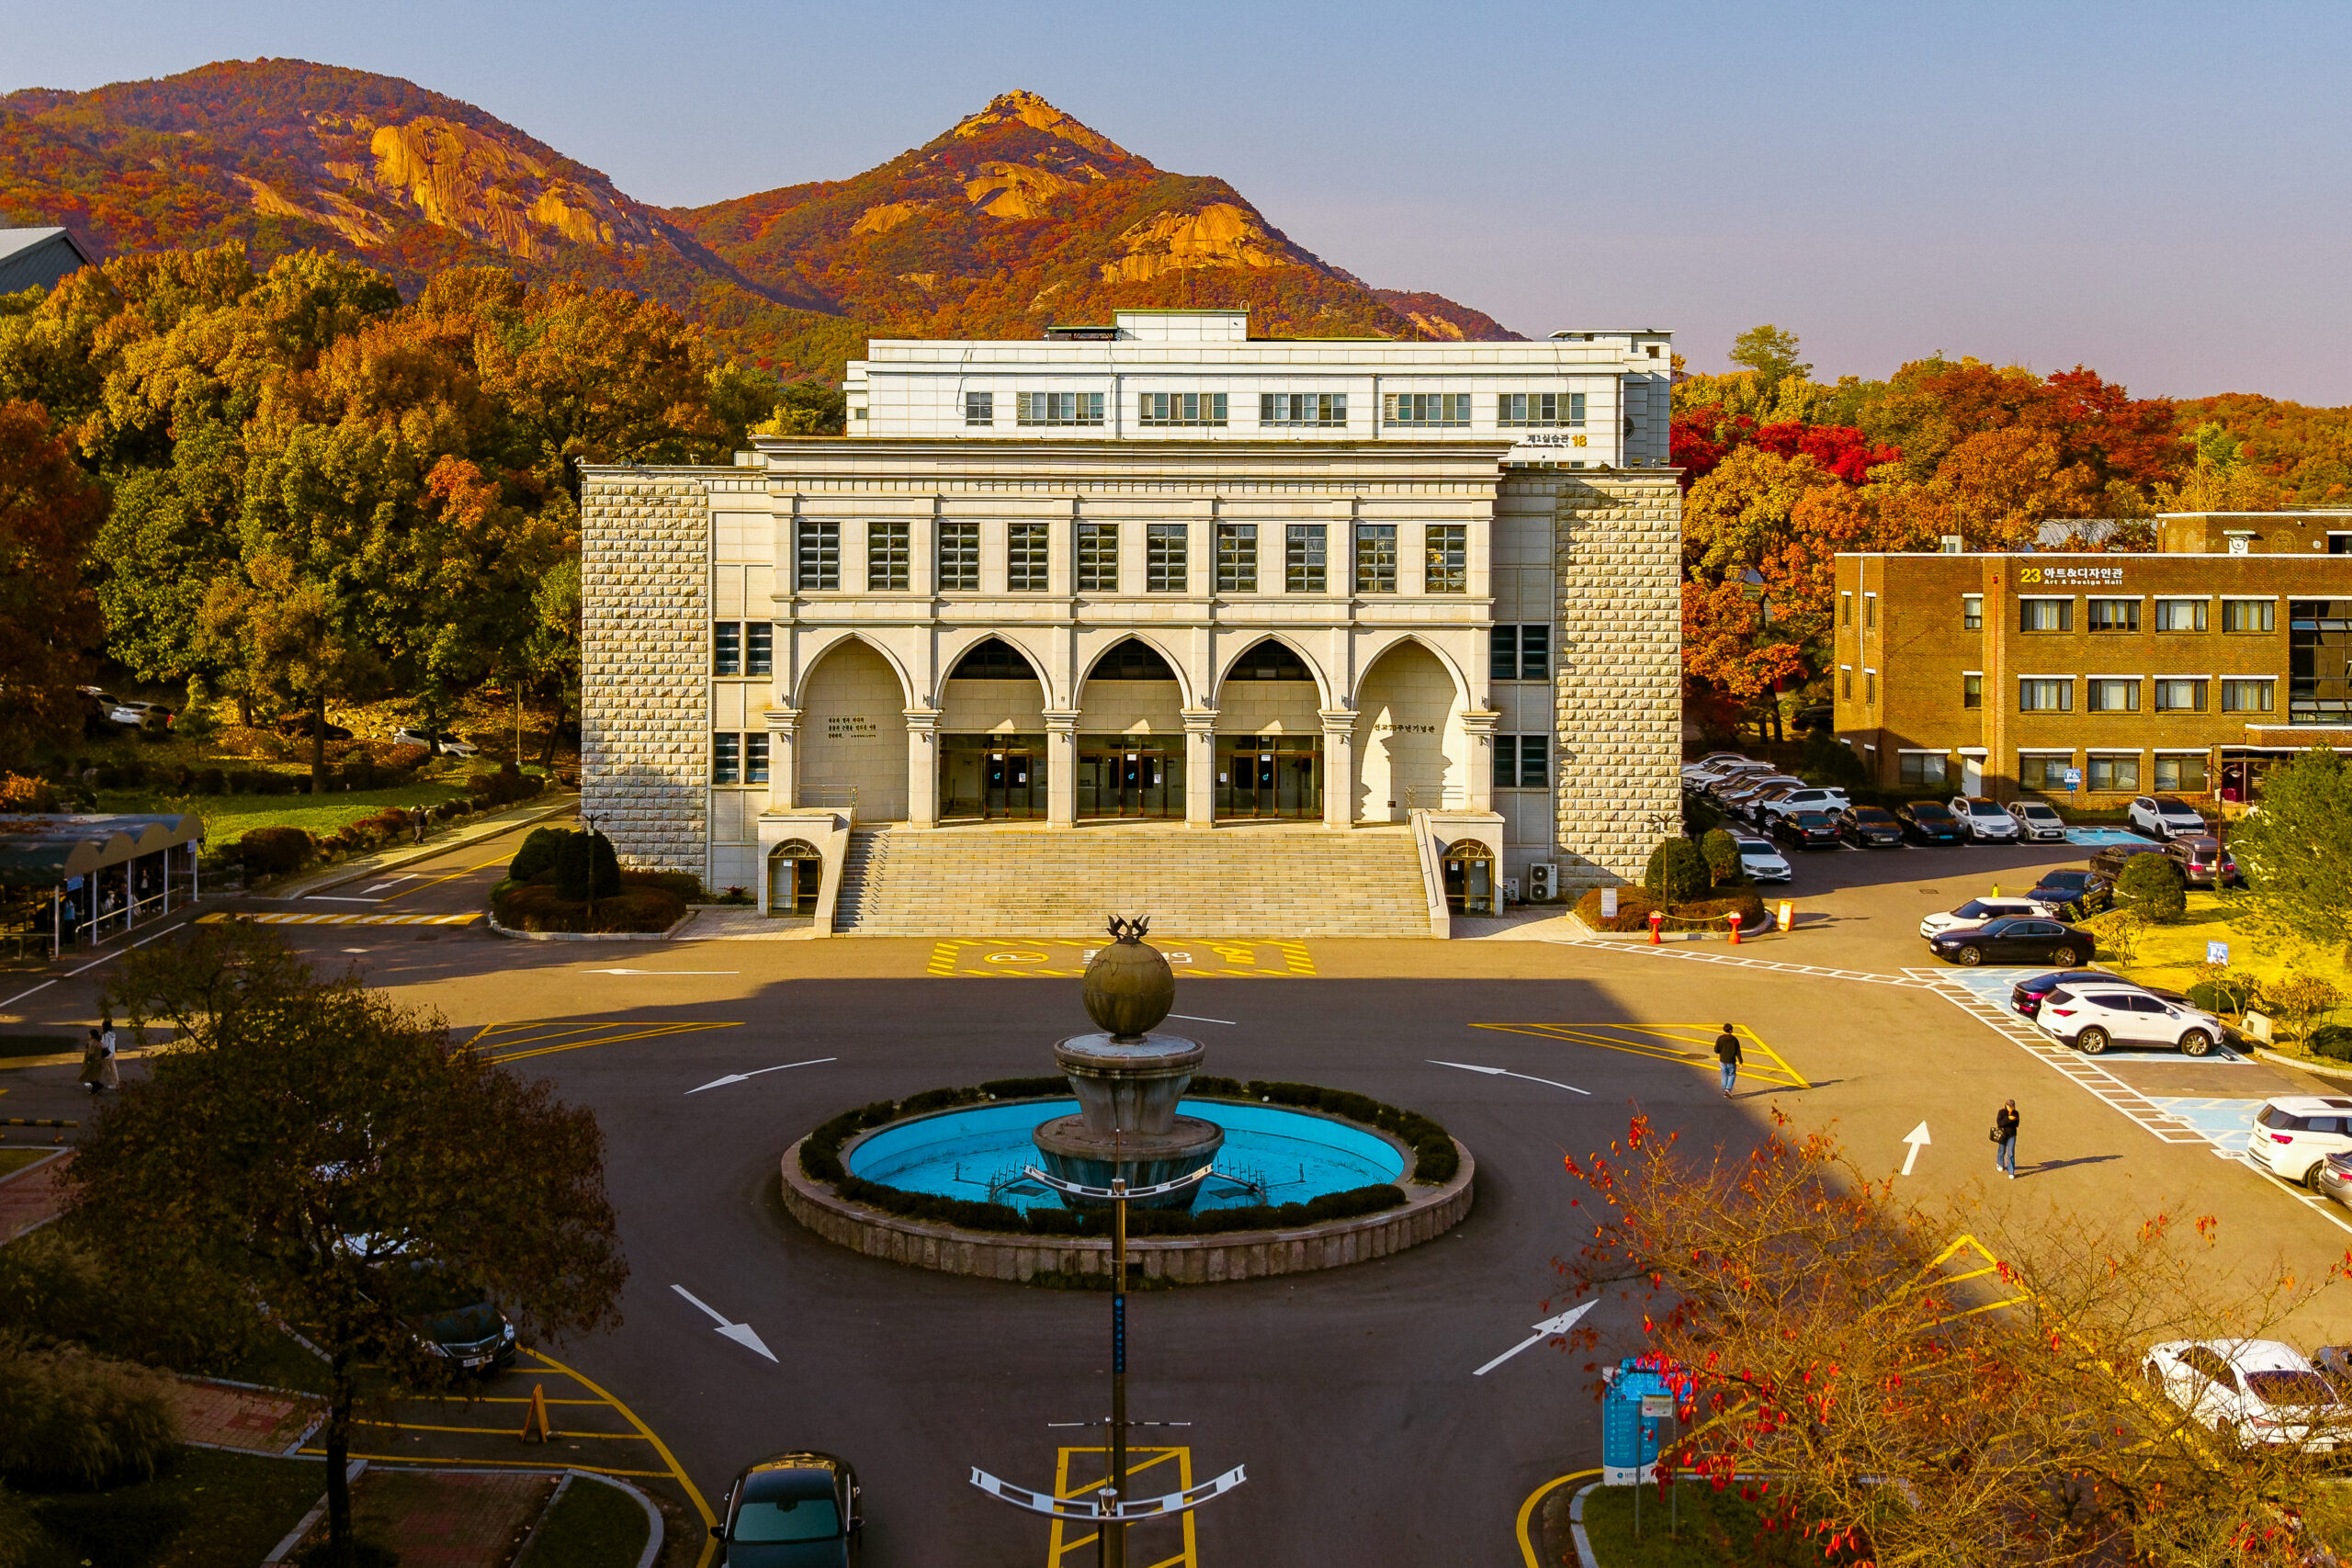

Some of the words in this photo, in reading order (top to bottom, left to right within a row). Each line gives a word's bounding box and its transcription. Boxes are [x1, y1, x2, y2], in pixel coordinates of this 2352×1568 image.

[1527, 434, 1568, 443] 제1실습관
[1571, 434, 1588, 447] 18
[2020, 568, 2041, 583] 23
[2043, 568, 2123, 579] 아트&디자인관
